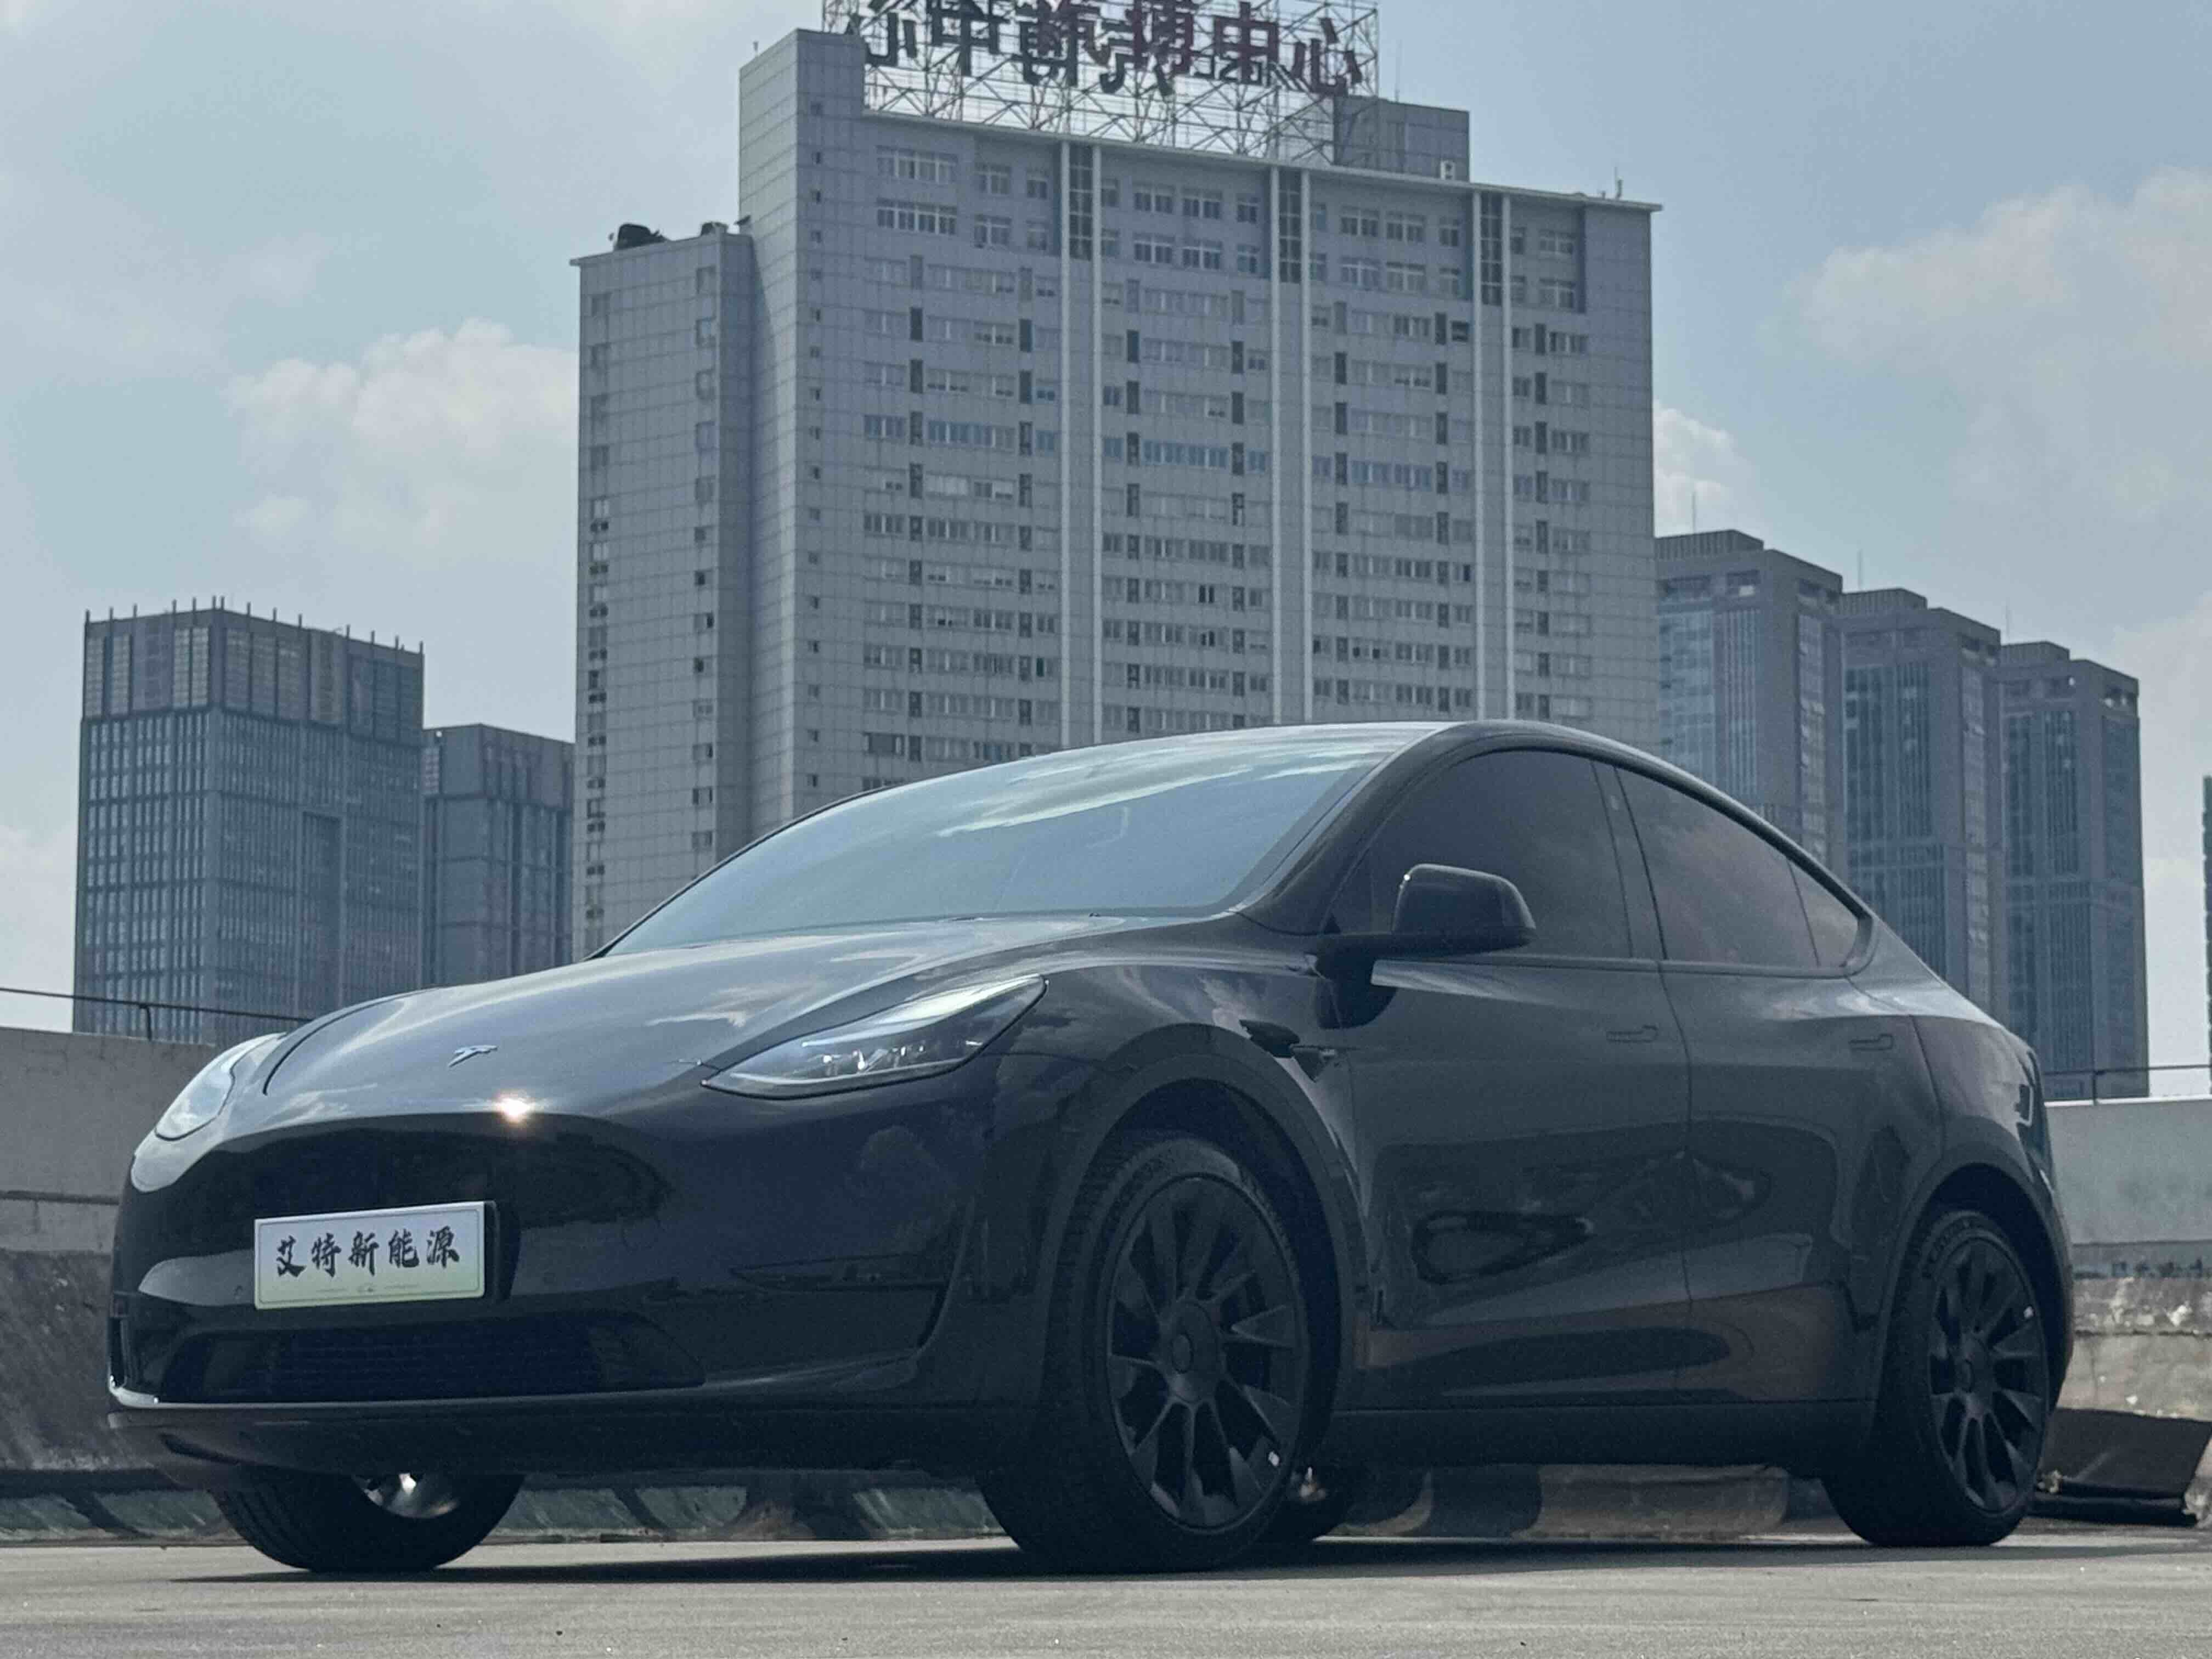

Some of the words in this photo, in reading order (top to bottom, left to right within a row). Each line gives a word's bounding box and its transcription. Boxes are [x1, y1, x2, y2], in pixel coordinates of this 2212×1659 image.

[276, 1225, 460, 1278] 艾特新能源
